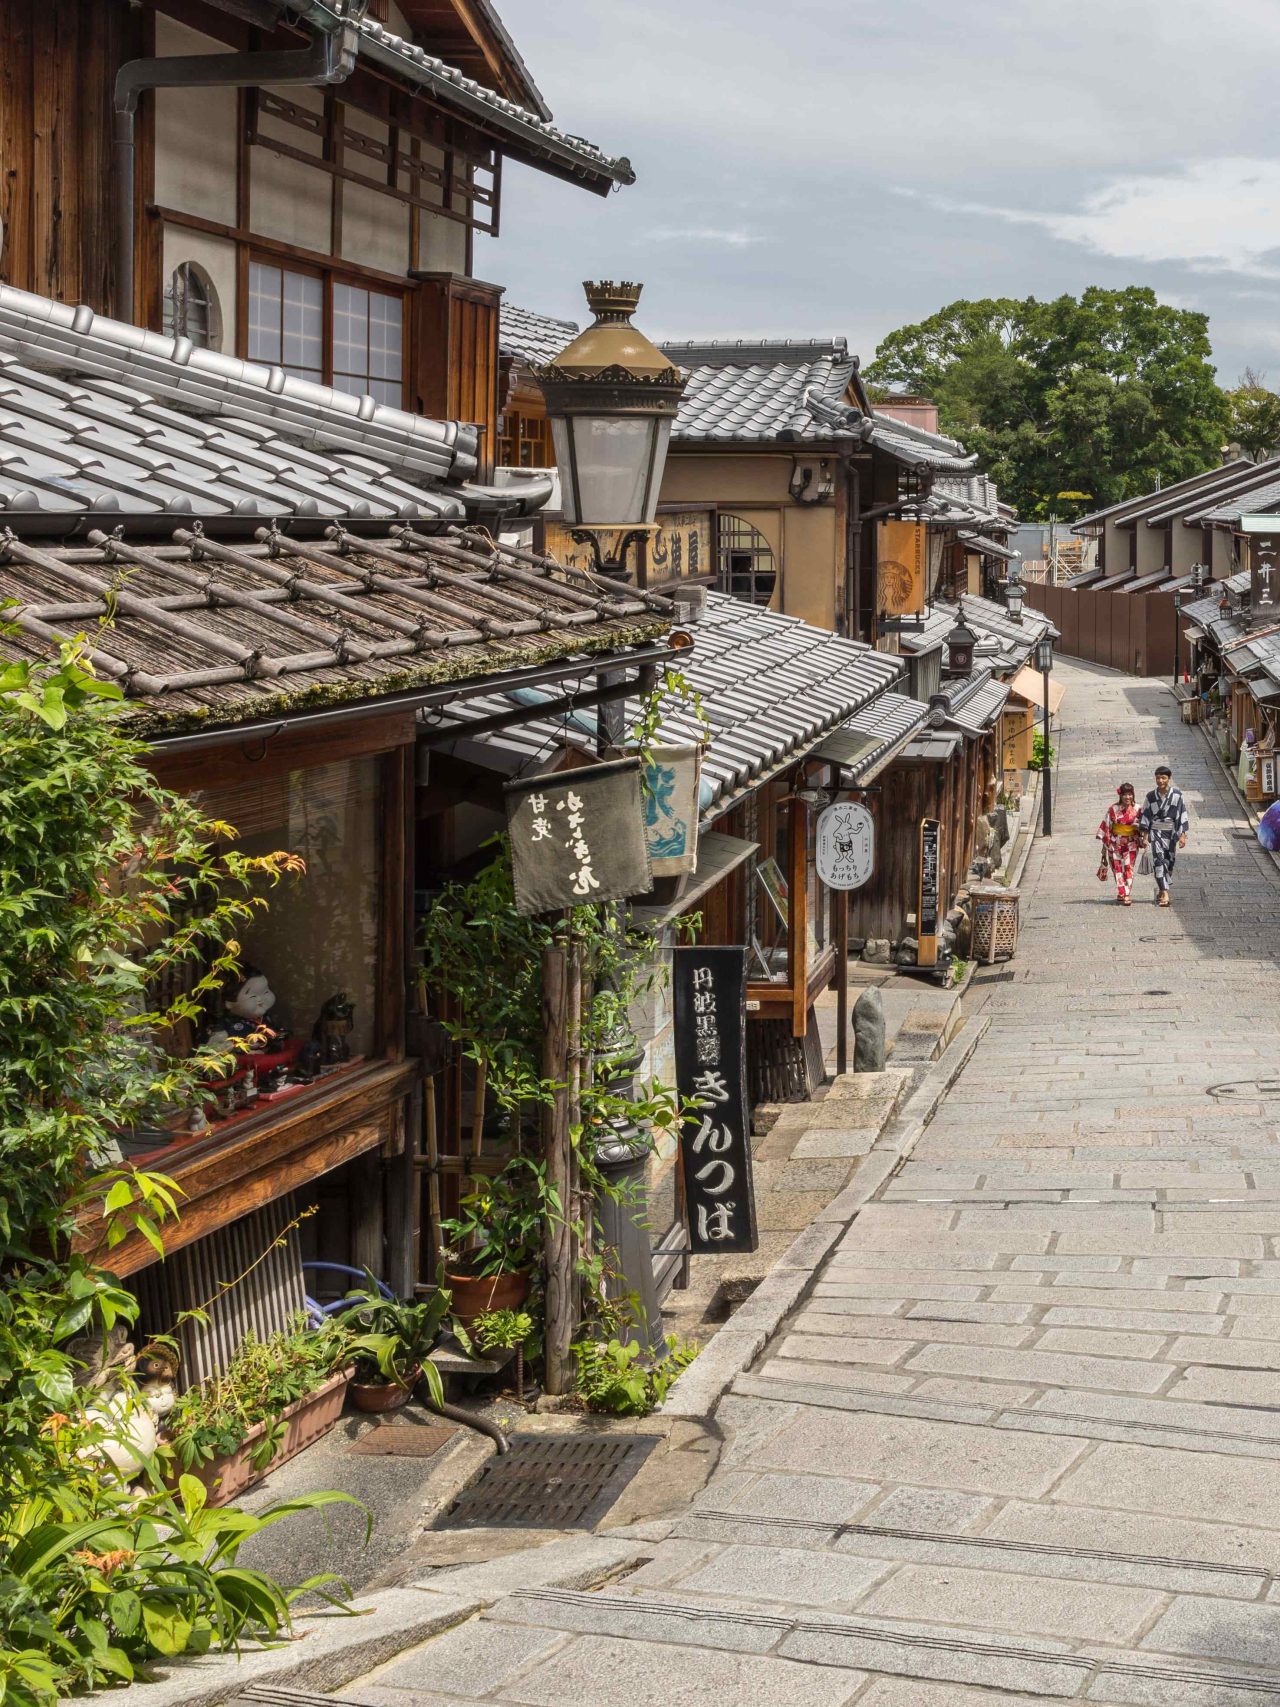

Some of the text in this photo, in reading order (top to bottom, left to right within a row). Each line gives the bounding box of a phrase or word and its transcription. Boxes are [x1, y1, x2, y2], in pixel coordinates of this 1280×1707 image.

[1257, 541, 1278, 605] 二井三
[528, 793, 552, 841] 甘党
[830, 873, 859, 881] あげもち
[833, 864, 858, 872] もっちり
